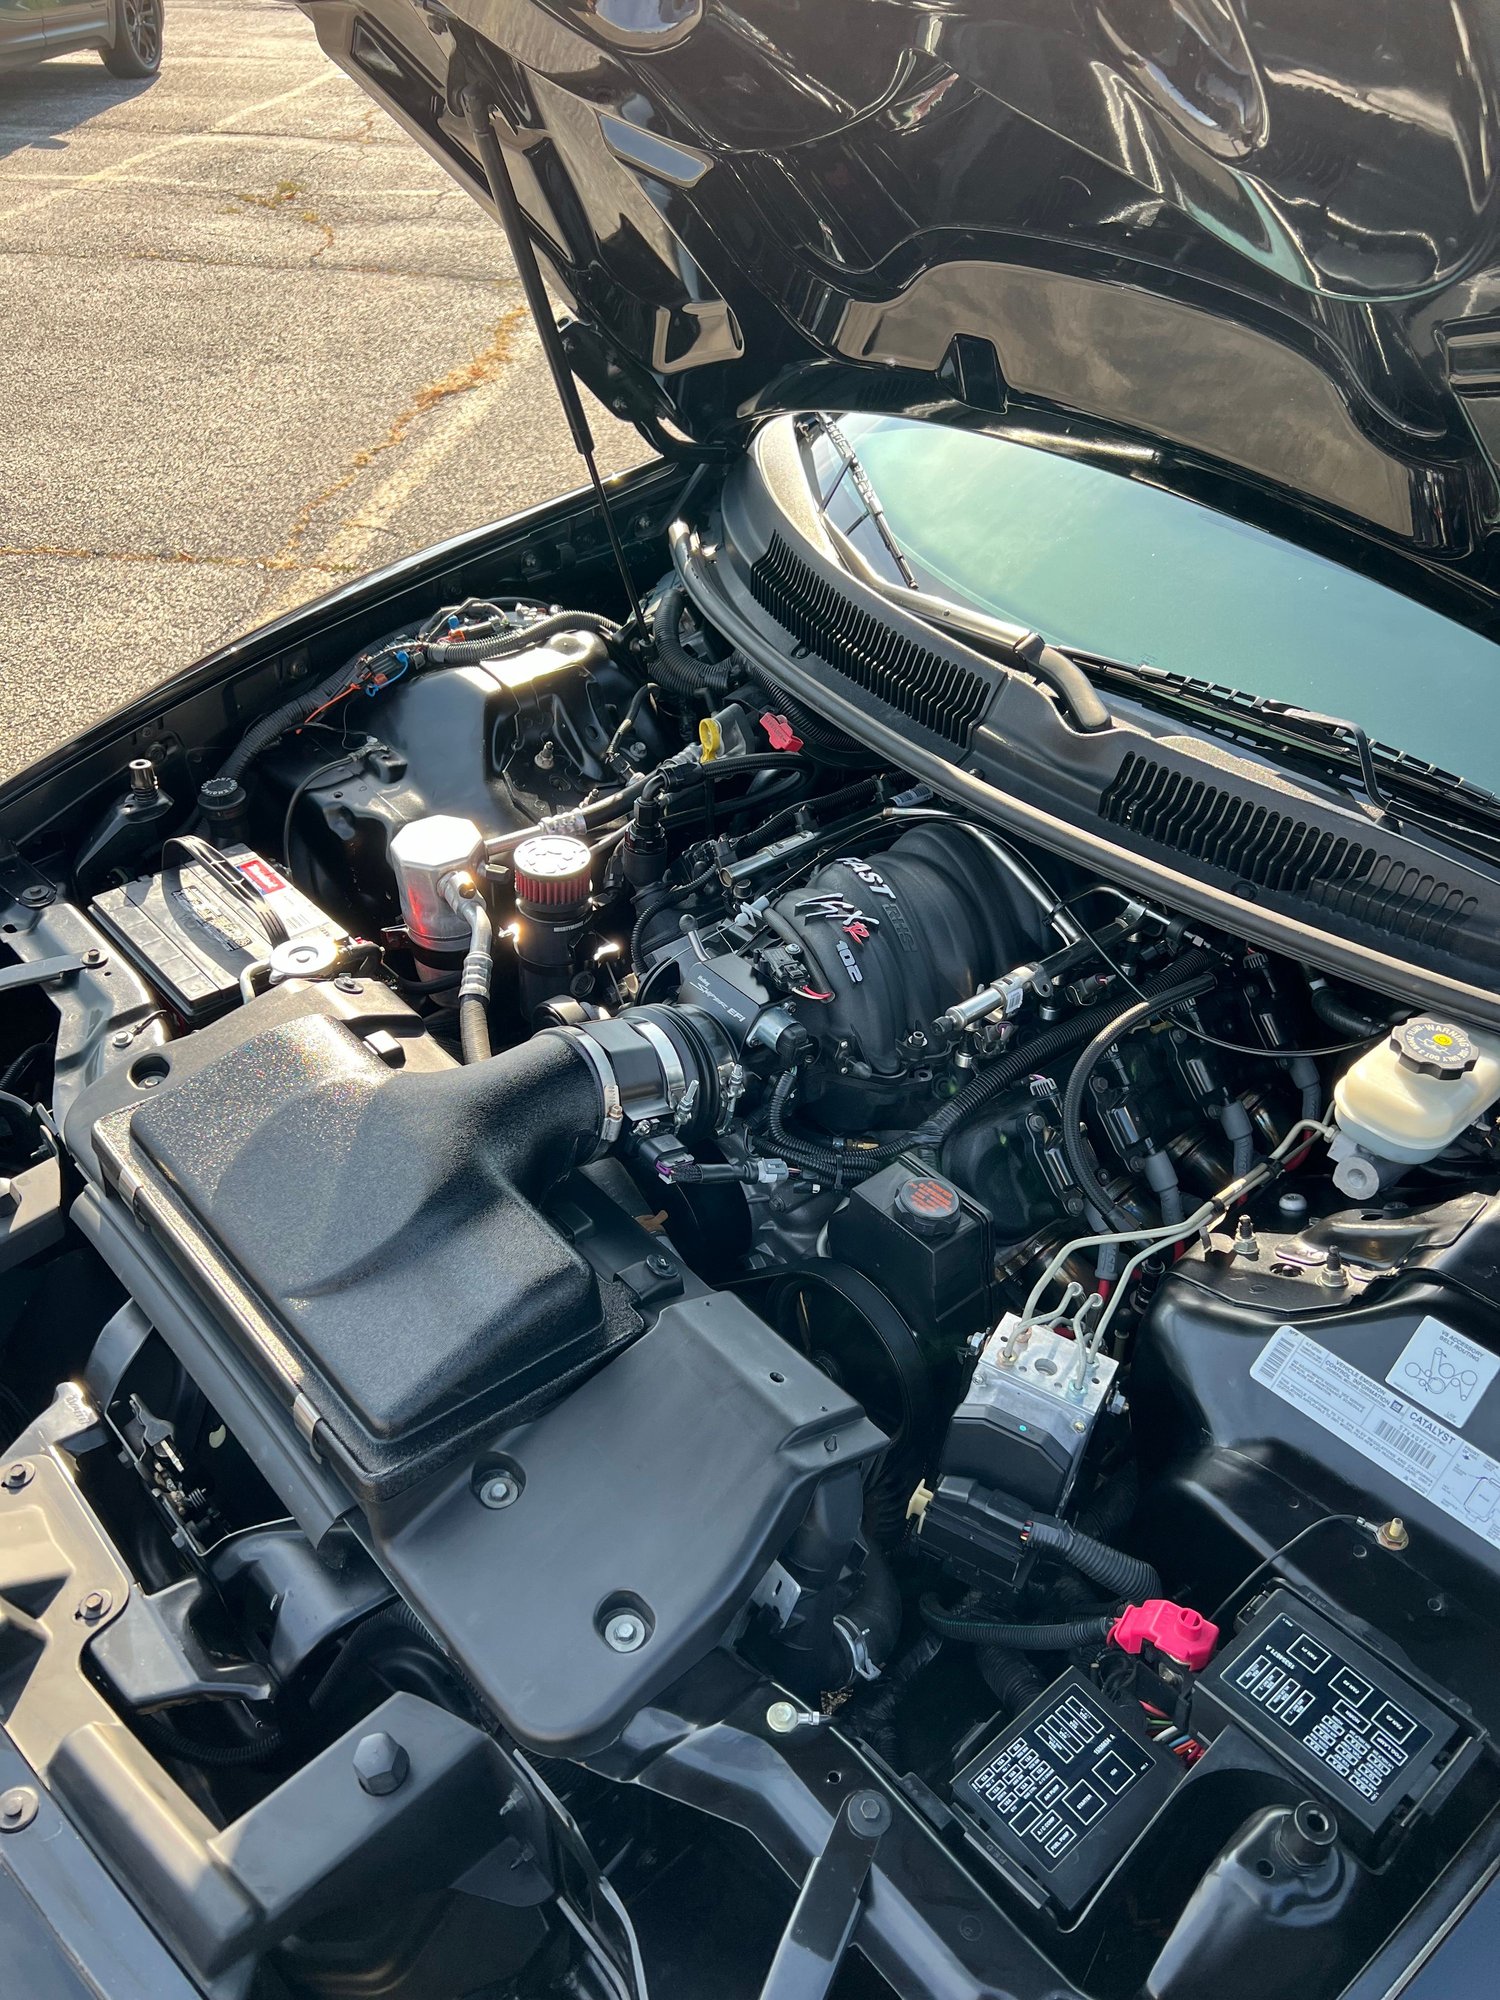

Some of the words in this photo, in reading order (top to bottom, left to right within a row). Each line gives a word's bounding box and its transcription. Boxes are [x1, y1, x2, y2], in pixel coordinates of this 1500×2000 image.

[836, 857, 896, 900] FAST
[836, 940, 863, 983] 102
[726, 1005, 746, 1023] EFI
[1424, 1024, 1470, 1047] WARNING
[1438, 1335, 1453, 1346] BELT
[1453, 1343, 1480, 1362] ROUTING
[1449, 1334, 1484, 1358] ACCESSORY
[1324, 1359, 1351, 1380] CONTROL
[1352, 1376, 1390, 1406] INFORMATION
[1335, 1359, 1359, 1378] VEHICLE
[1358, 1375, 1386, 1396] EMISSION
[1408, 1410, 1455, 1446] CATALYST
[1344, 1709, 1360, 1724] HORN
[1375, 1736, 1392, 1750] LAMP
[1389, 1748, 1403, 1759] FOG
[1048, 1783, 1060, 1795] PUMP
[1075, 1792, 1092, 1810] STARTER
[1050, 1840, 1060, 1851] FUEL
[1058, 1830, 1070, 1842] PUMP
